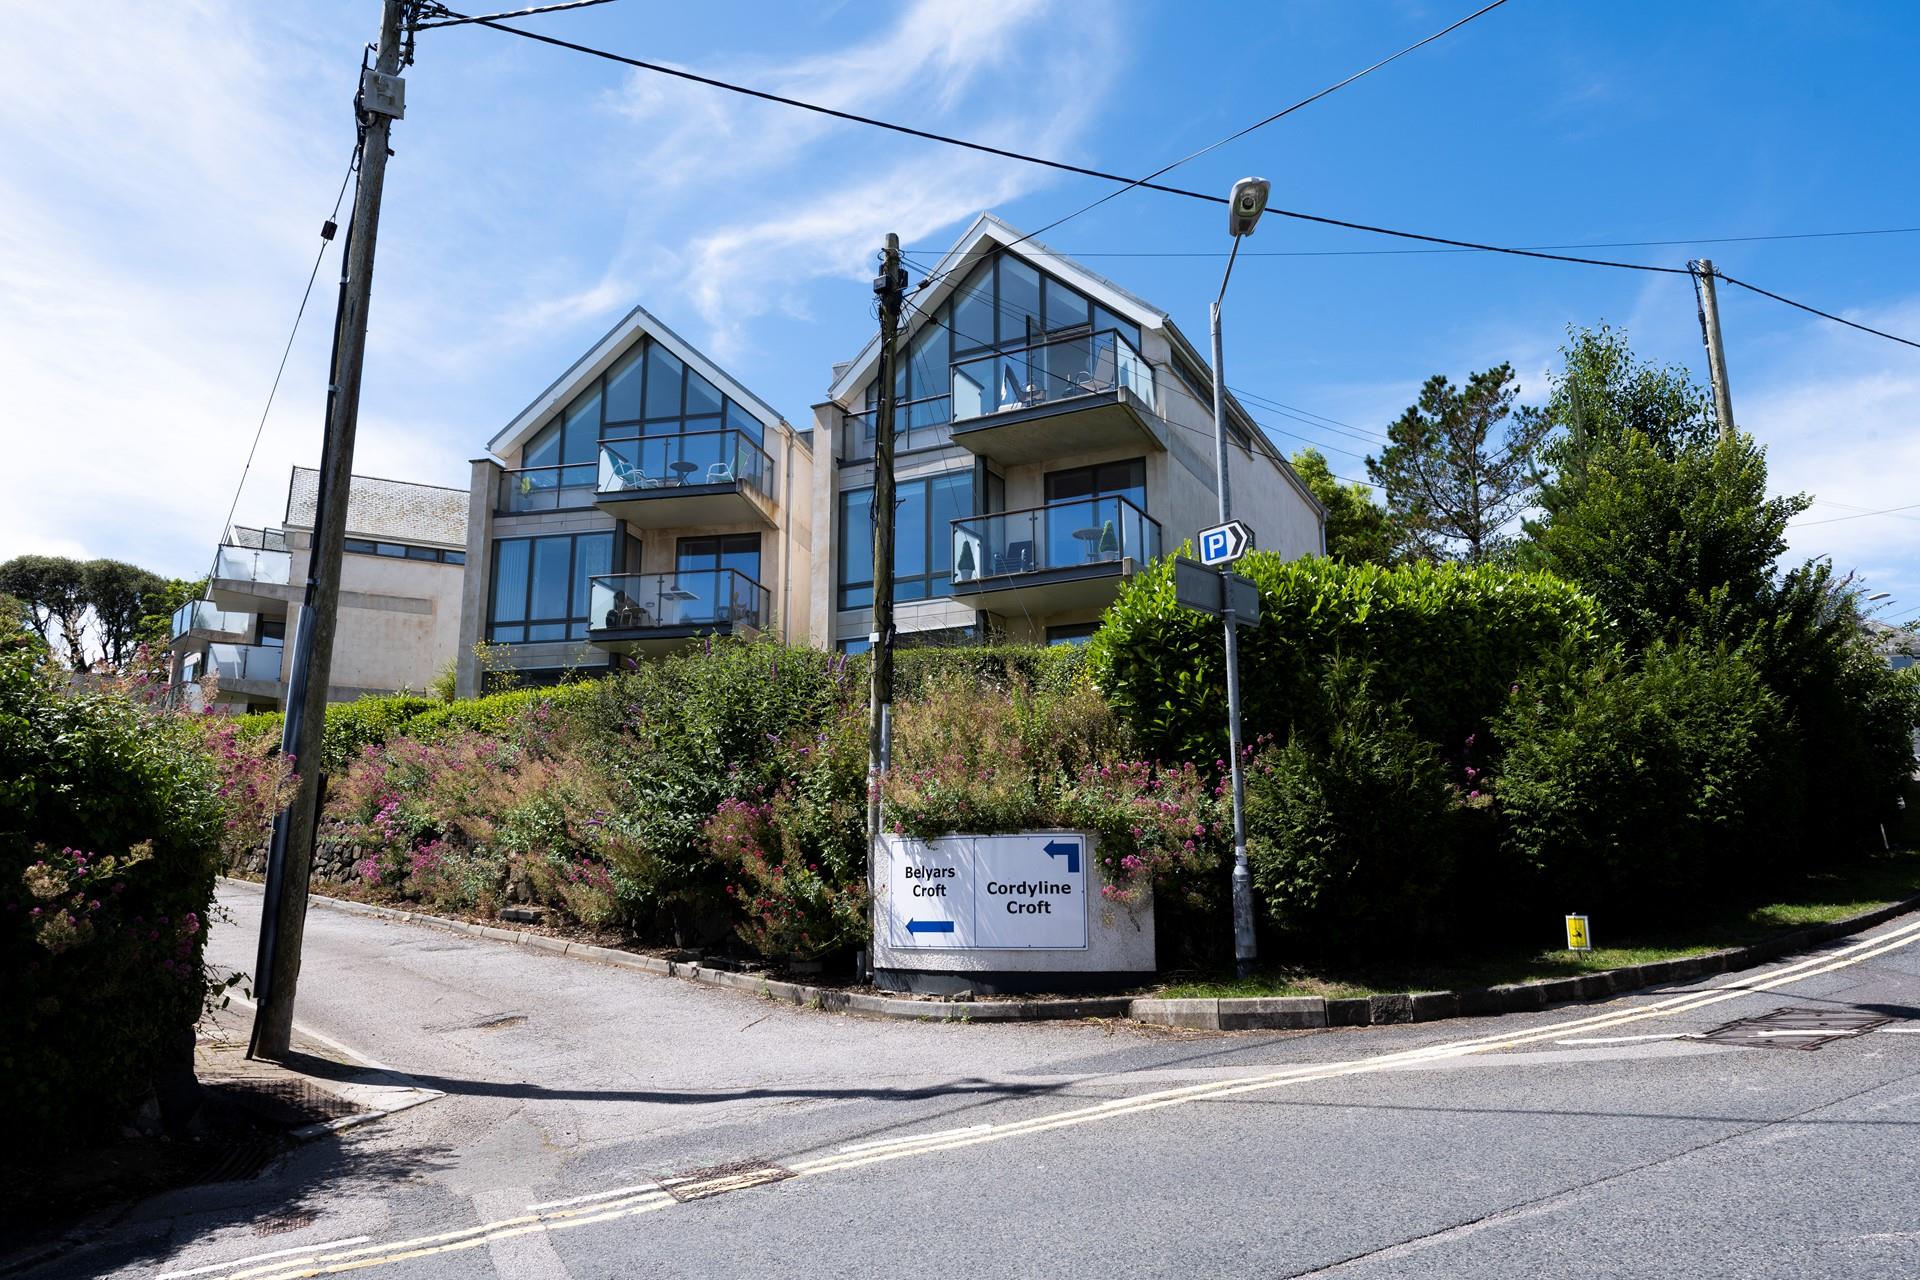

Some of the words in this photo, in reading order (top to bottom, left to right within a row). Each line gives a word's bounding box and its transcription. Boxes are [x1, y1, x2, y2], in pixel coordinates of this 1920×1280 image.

[1208, 534, 1224, 559] P
[905, 866, 956, 881] Belyars
[912, 884, 947, 897] Croft
[986, 881, 1072, 896] Cordyline
[1006, 900, 1052, 915] Croft
